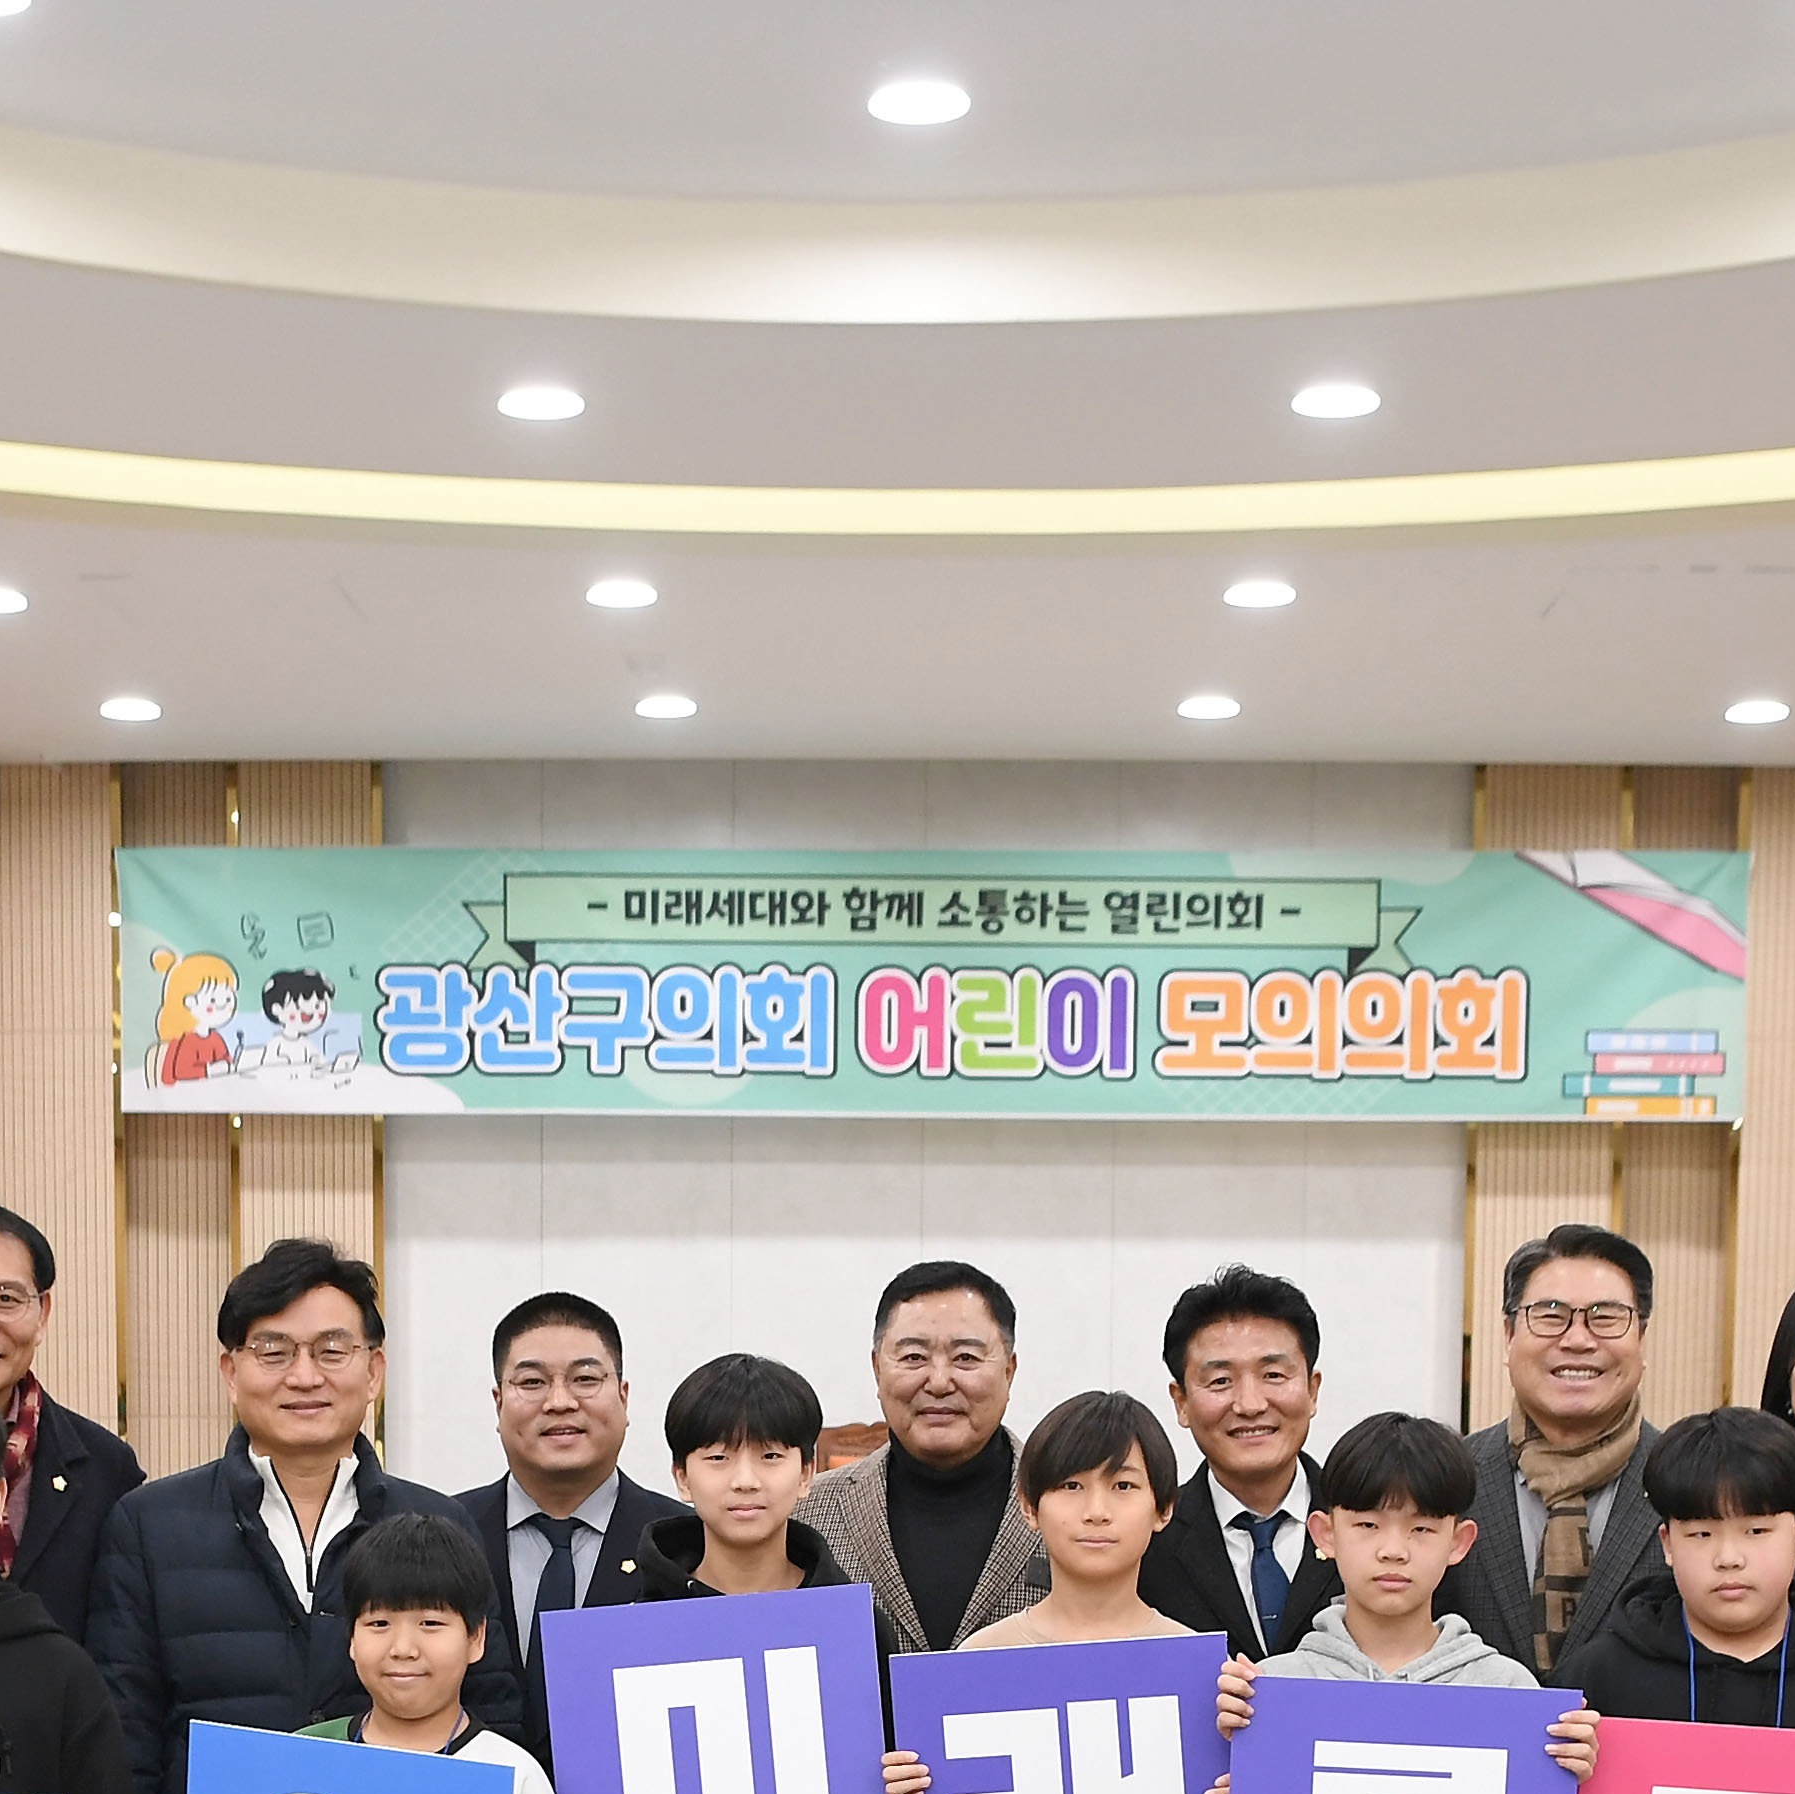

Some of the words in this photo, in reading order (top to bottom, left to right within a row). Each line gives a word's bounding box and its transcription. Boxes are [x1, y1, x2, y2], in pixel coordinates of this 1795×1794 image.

[624, 889, 831, 927] 미래세대와
[843, 886, 924, 932] 함께
[937, 889, 1090, 935] 소통하는
[1103, 890, 1264, 934] 열린의회
[378, 965, 834, 1075] 광산구의회
[858, 966, 1136, 1077] 어린이
[1156, 968, 1527, 1078] 모의의회
